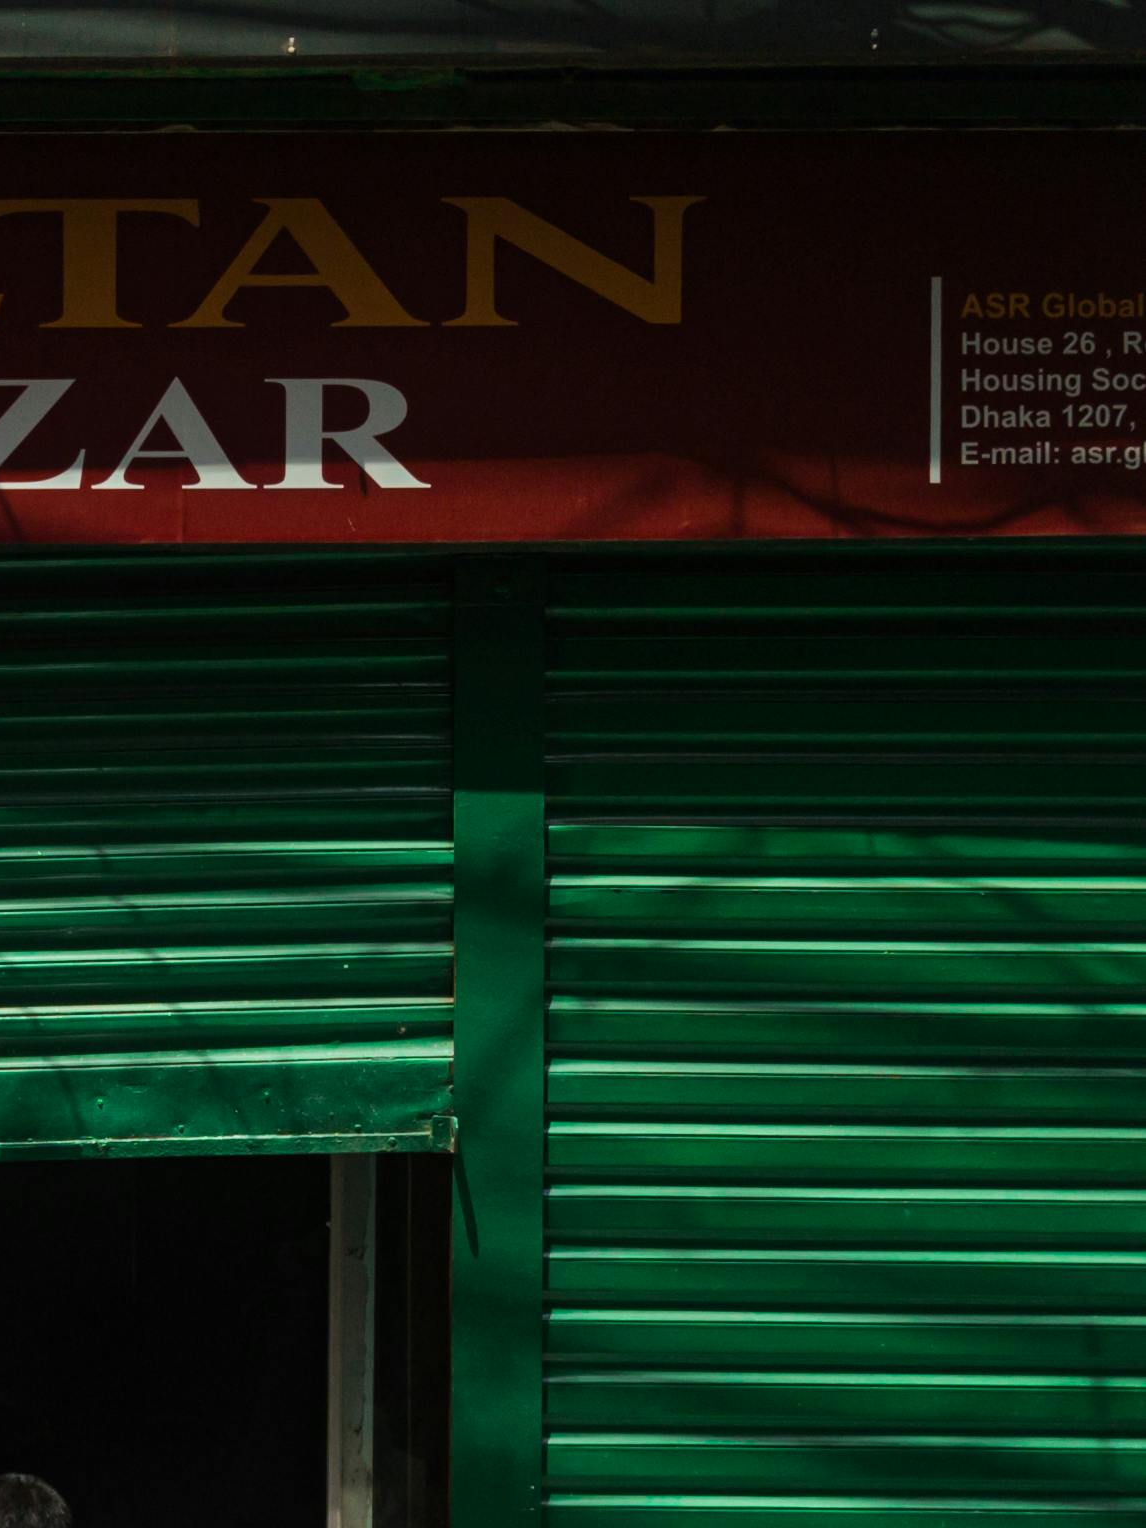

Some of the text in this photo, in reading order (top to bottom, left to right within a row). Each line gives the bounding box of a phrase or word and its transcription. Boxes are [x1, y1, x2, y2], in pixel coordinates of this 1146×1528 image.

[961, 293, 1145, 319] ASR Global
[961, 332, 1053, 355] House
[961, 368, 1082, 398] Housing
[961, 404, 1136, 431] Dhaka 1207,
[960, 441, 1060, 465] E-mail:
